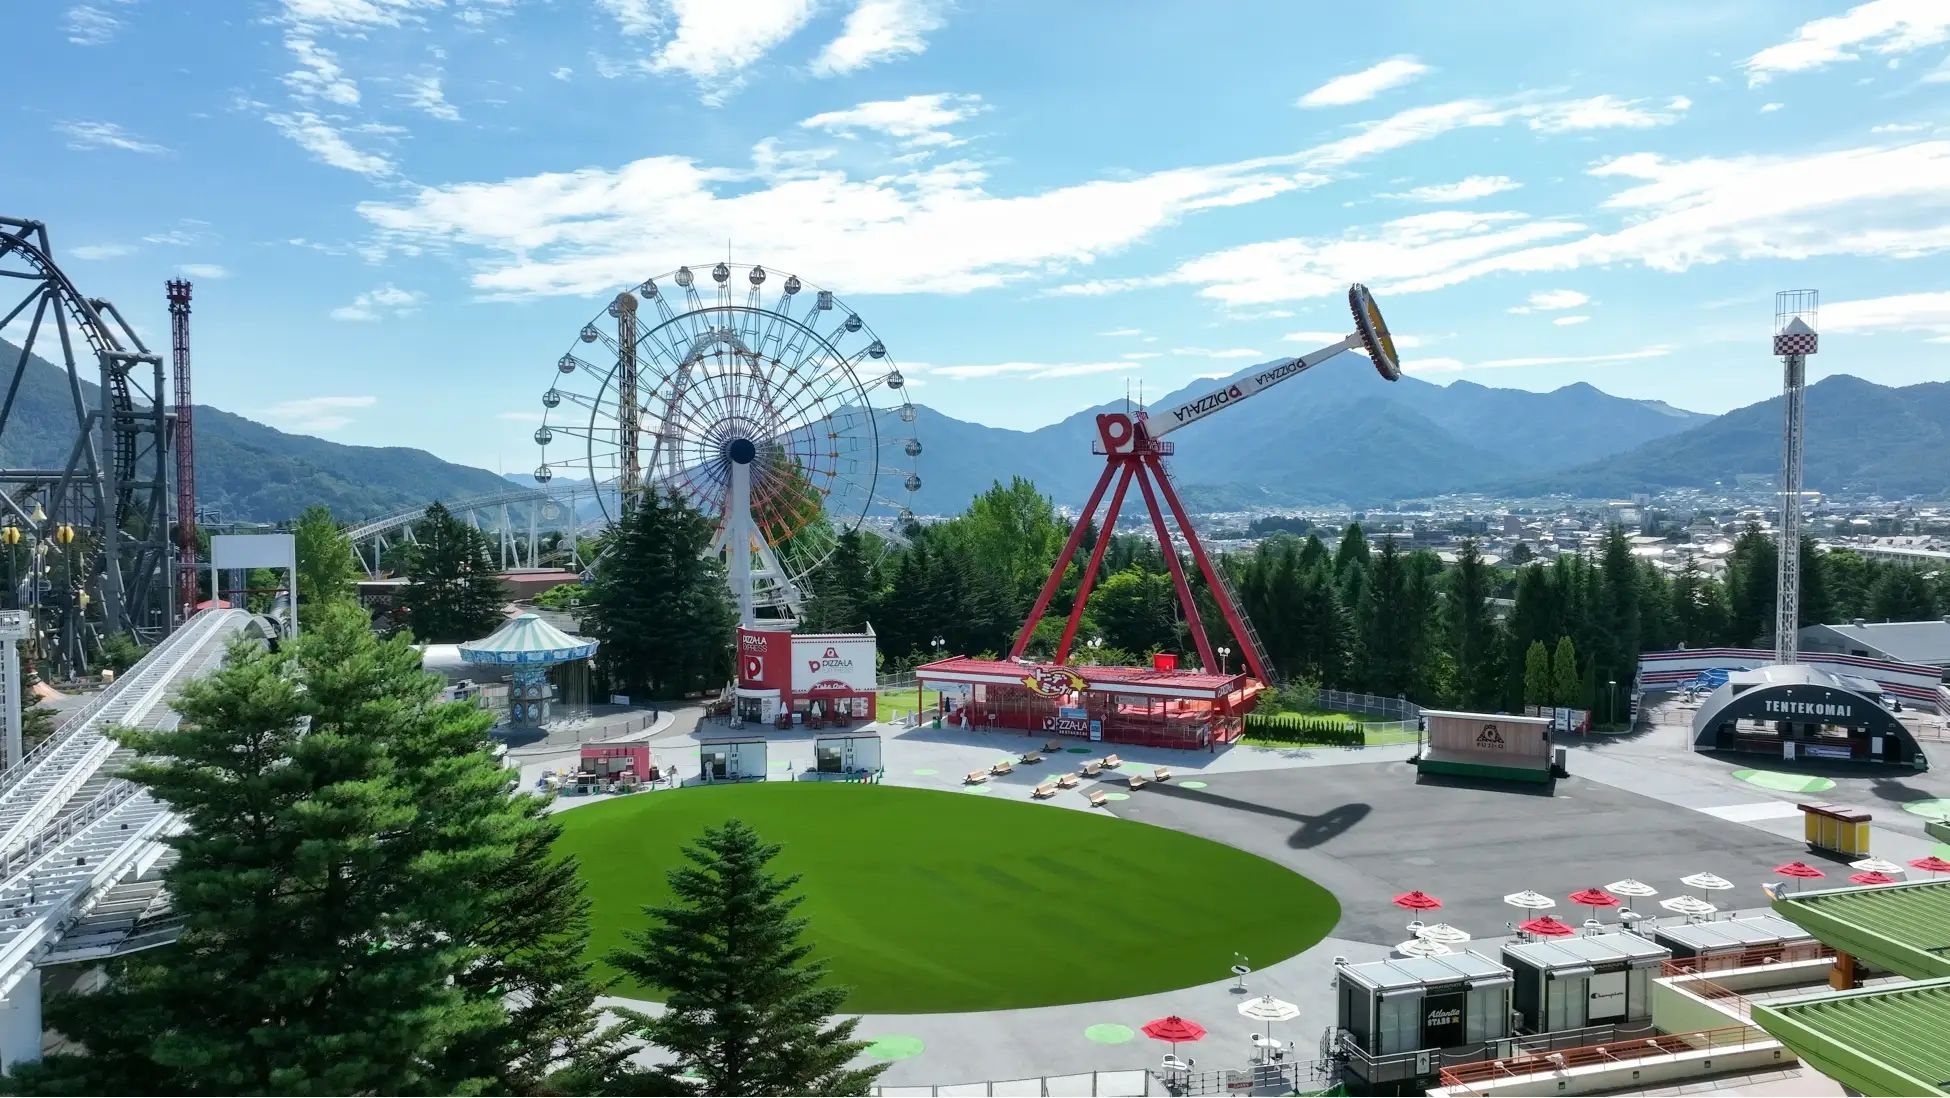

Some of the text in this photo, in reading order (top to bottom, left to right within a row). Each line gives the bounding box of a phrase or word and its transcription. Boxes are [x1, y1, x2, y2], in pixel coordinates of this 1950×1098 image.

[1255, 360, 1296, 385] PIZZA-LA
[1173, 389, 1229, 422] PIZZA-LA
[743, 635, 767, 645] PIZZA-LA
[822, 659, 853, 667] PIZZA-LA
[1765, 700, 1852, 717] TENTEKOMAI
[1428, 1008, 1461, 1019] Atlantic
[1427, 1017, 1451, 1027] STARS
